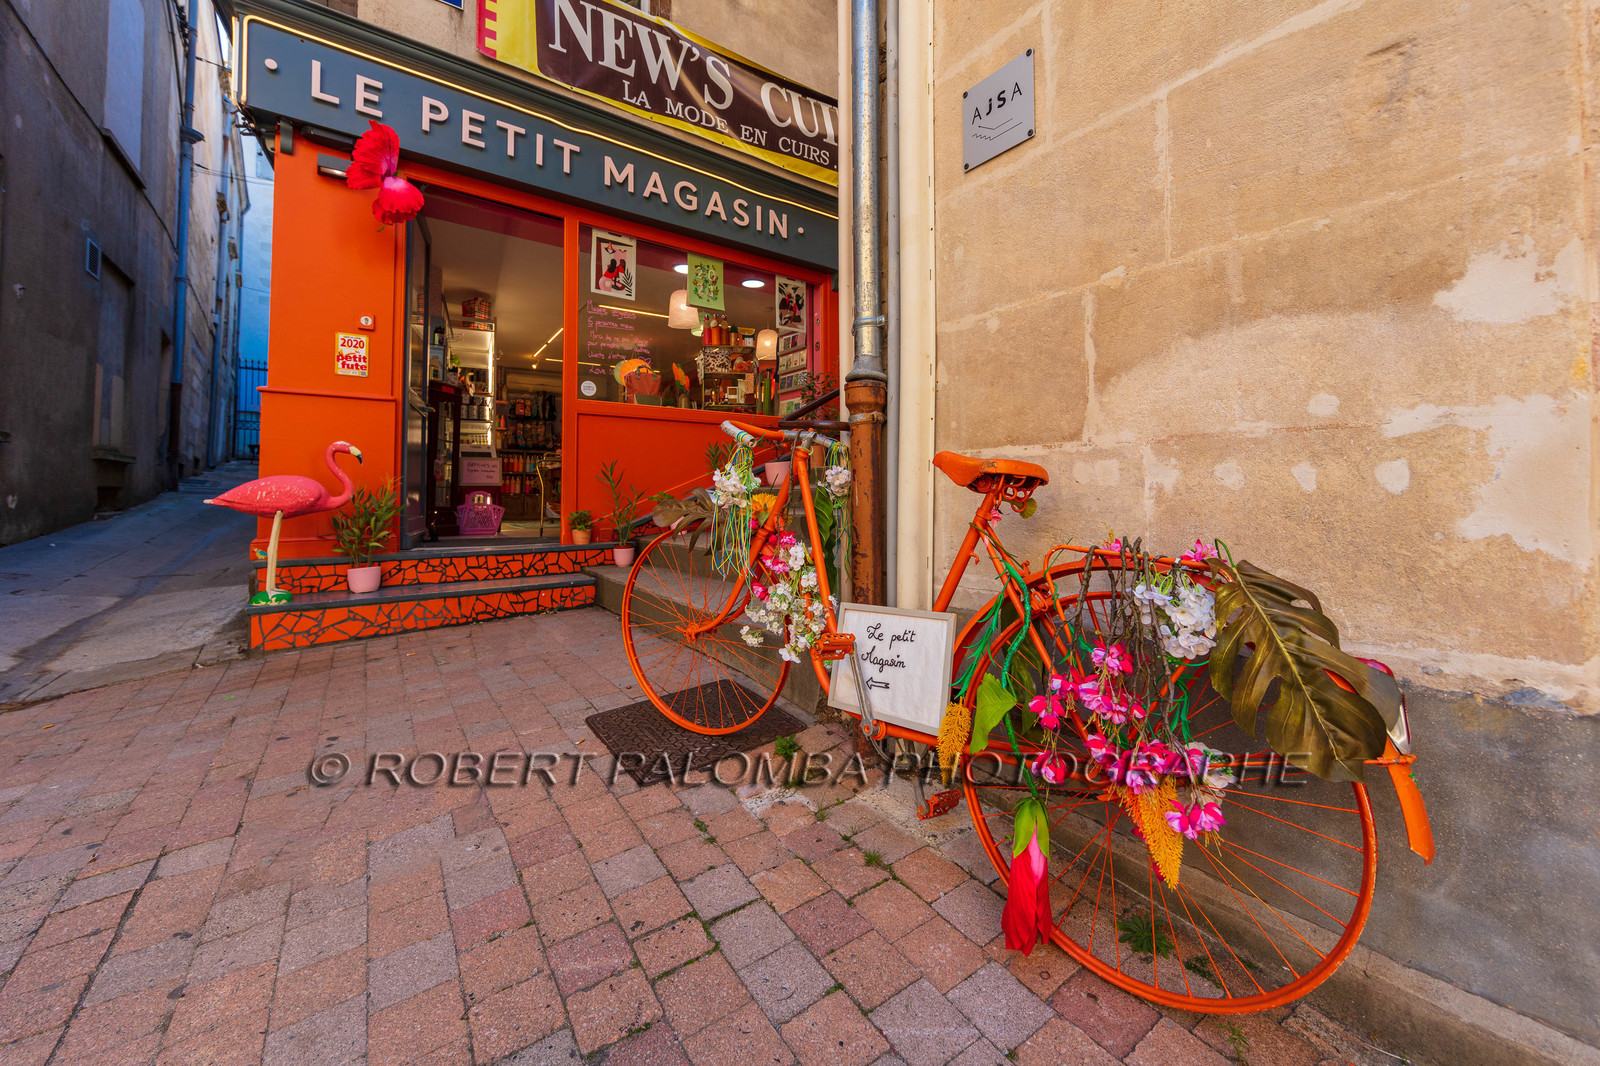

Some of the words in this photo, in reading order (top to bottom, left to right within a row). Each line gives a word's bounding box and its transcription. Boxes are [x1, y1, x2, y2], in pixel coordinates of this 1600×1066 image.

[549, 0, 734, 110] NEW'S
[761, 82, 838, 147] CUI
[622, 80, 652, 109] LA
[665, 97, 729, 133] MODE
[740, 124, 768, 146] EN
[311, 59, 383, 118] LE
[421, 95, 581, 174] PETIT
[603, 155, 788, 239] MAGASIN
[587, 316, 594, 327] 6
[340, 337, 365, 349] 2020
[336, 354, 368, 363] petit
[866, 623, 884, 642] Le
[889, 629, 916, 650] petit
